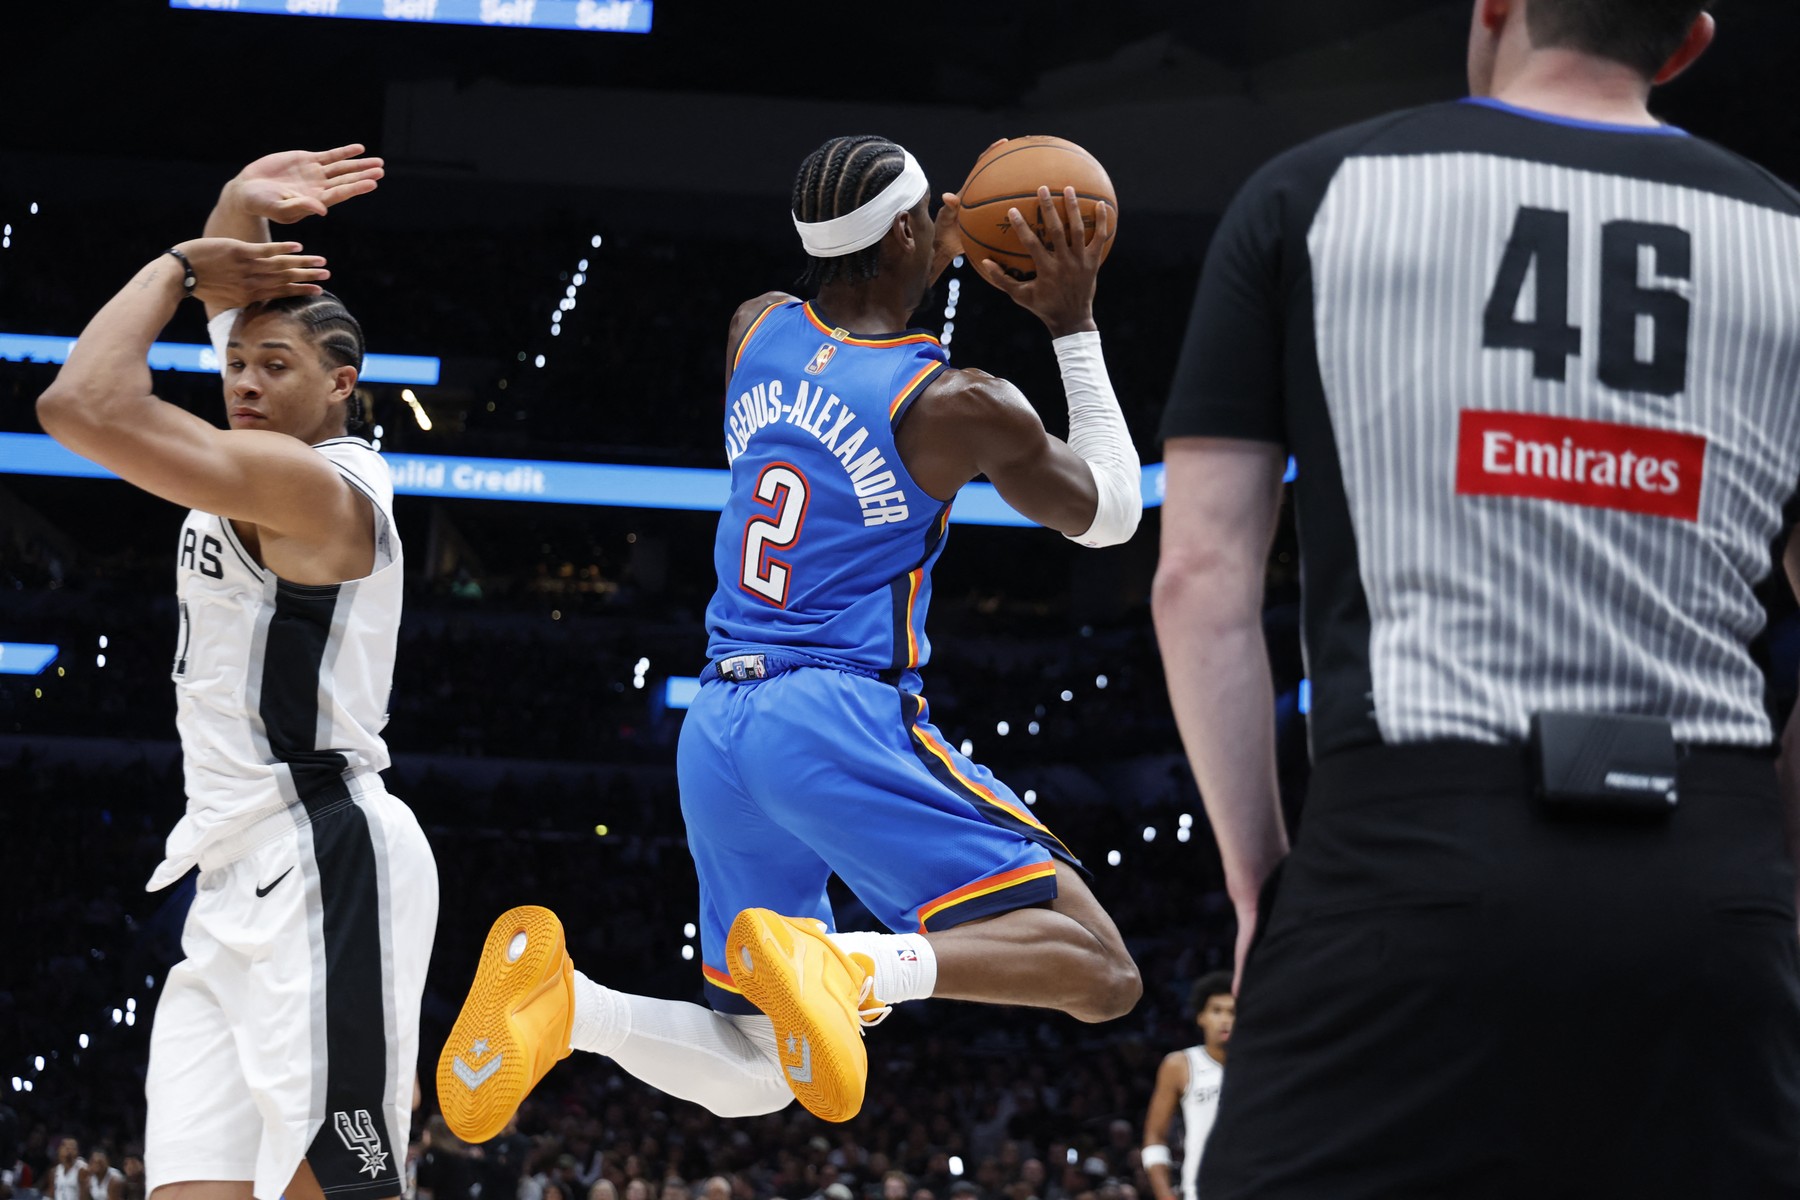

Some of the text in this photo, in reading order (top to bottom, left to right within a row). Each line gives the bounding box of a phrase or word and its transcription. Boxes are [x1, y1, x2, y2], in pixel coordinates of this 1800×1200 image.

[479, 0, 536, 25] Self
[575, 0, 634, 30] Self
[1482, 205, 1691, 398] 46
[452, 464, 545, 495] Credit
[1482, 430, 1680, 494] Emirates
[180, 527, 224, 580] RS
[739, 461, 811, 610] 2
